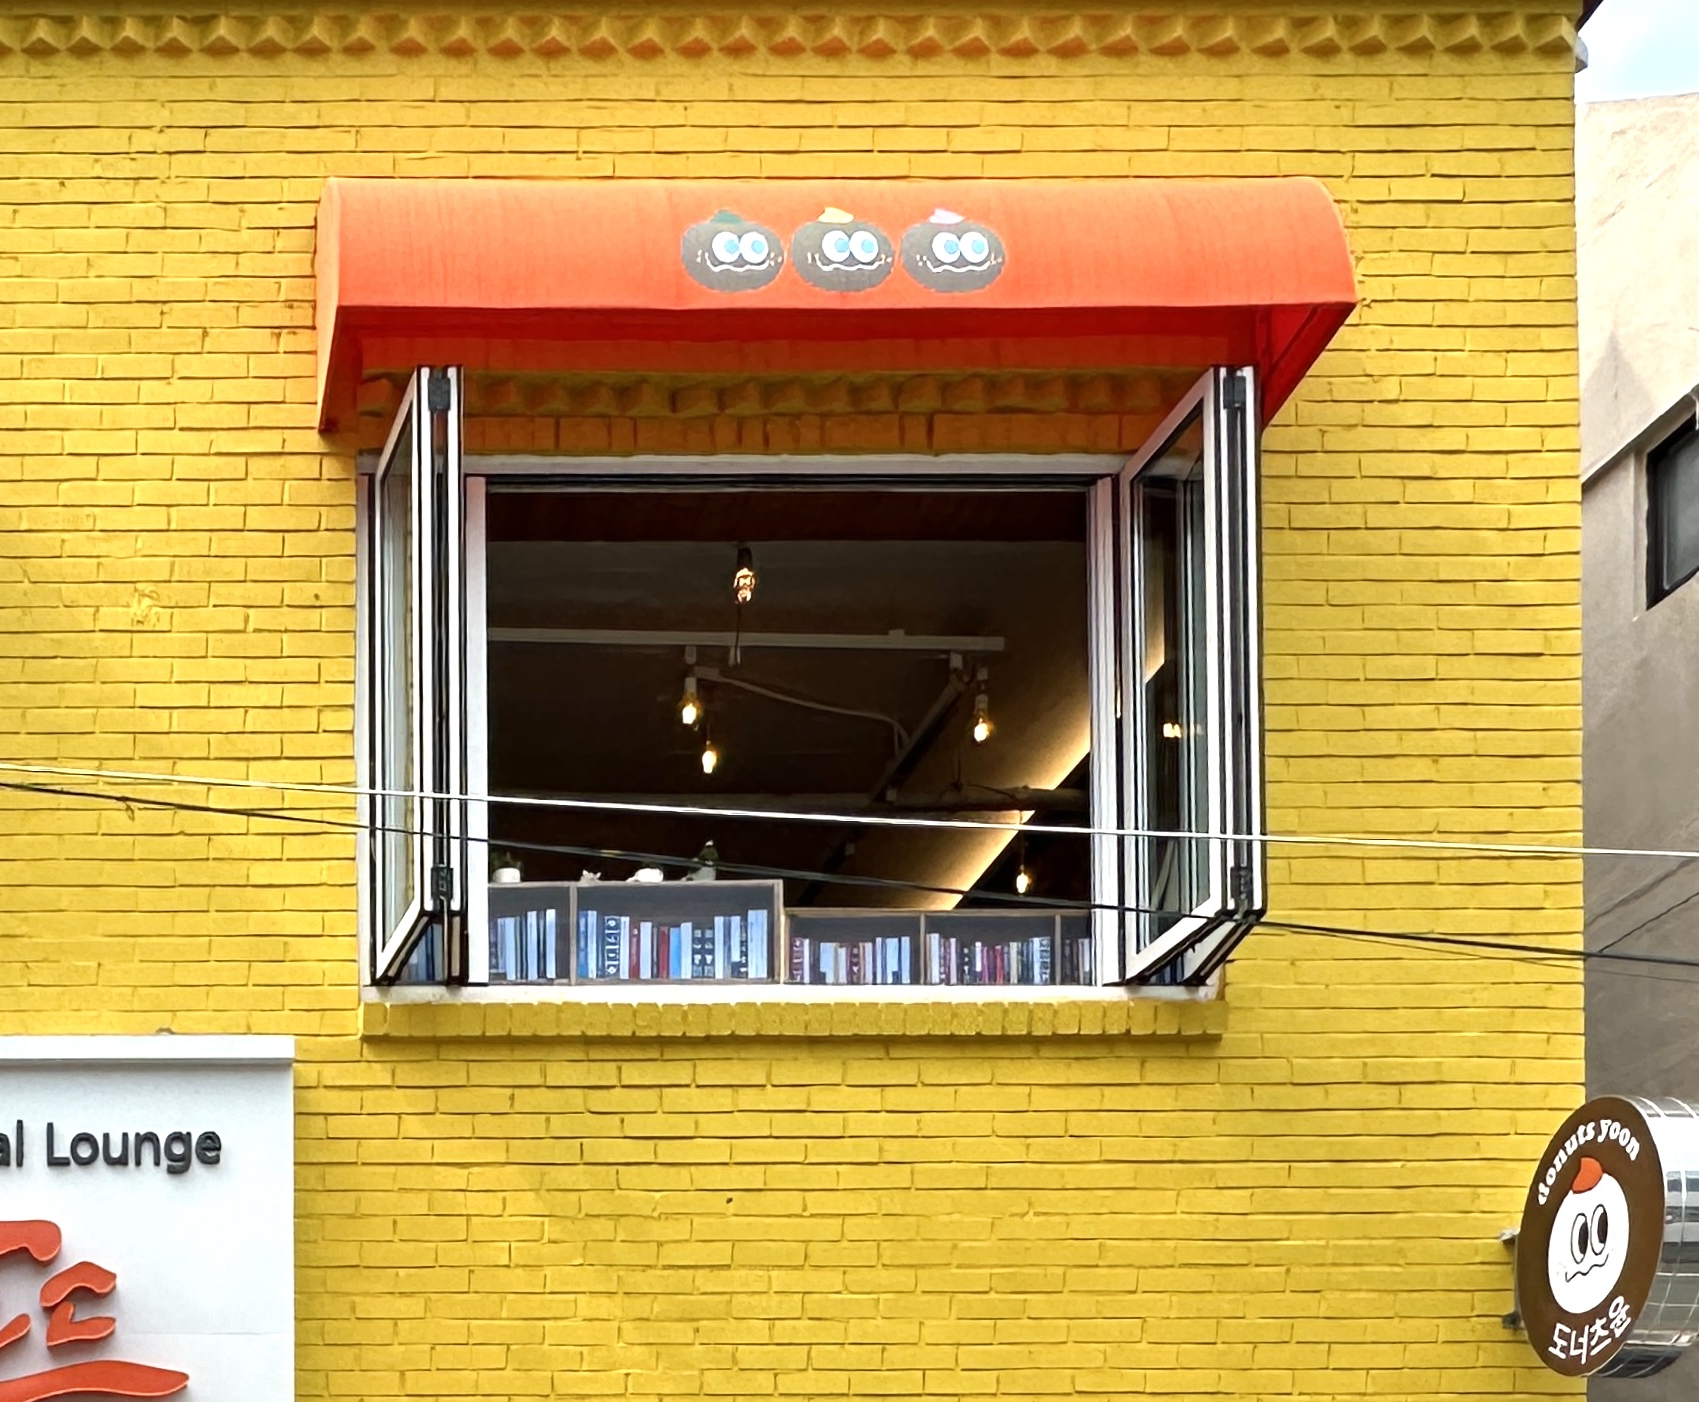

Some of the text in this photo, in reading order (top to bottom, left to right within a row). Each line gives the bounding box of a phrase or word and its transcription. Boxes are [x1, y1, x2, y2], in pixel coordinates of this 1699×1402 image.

[45, 1121, 222, 1176] Lounge
[1537, 1118, 1641, 1206] donuts yoon
[1548, 1295, 1633, 1365] 도너츠윤
